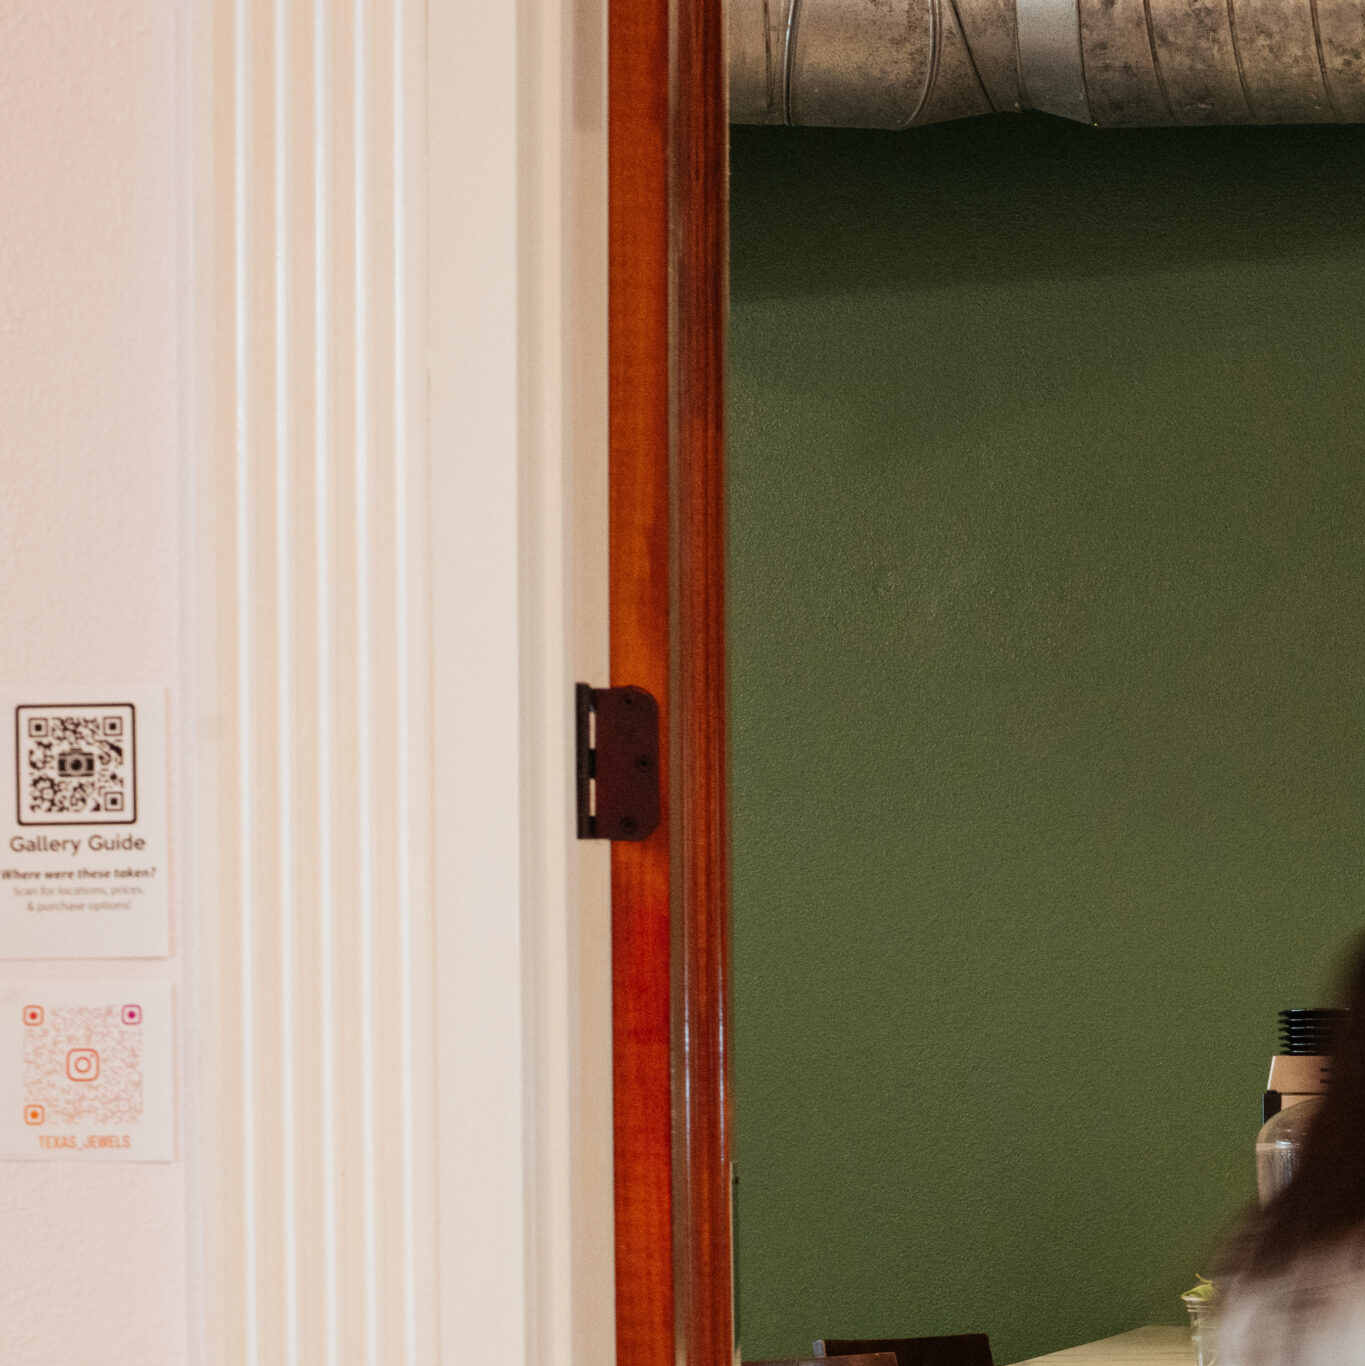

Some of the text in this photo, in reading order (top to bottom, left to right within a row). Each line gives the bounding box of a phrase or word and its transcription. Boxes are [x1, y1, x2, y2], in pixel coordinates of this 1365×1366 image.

[9, 834, 147, 856] Gallery Guide
[1, 866, 157, 880] Where were these taken?
[37, 1135, 131, 1151] TEXAS_JEWELS
